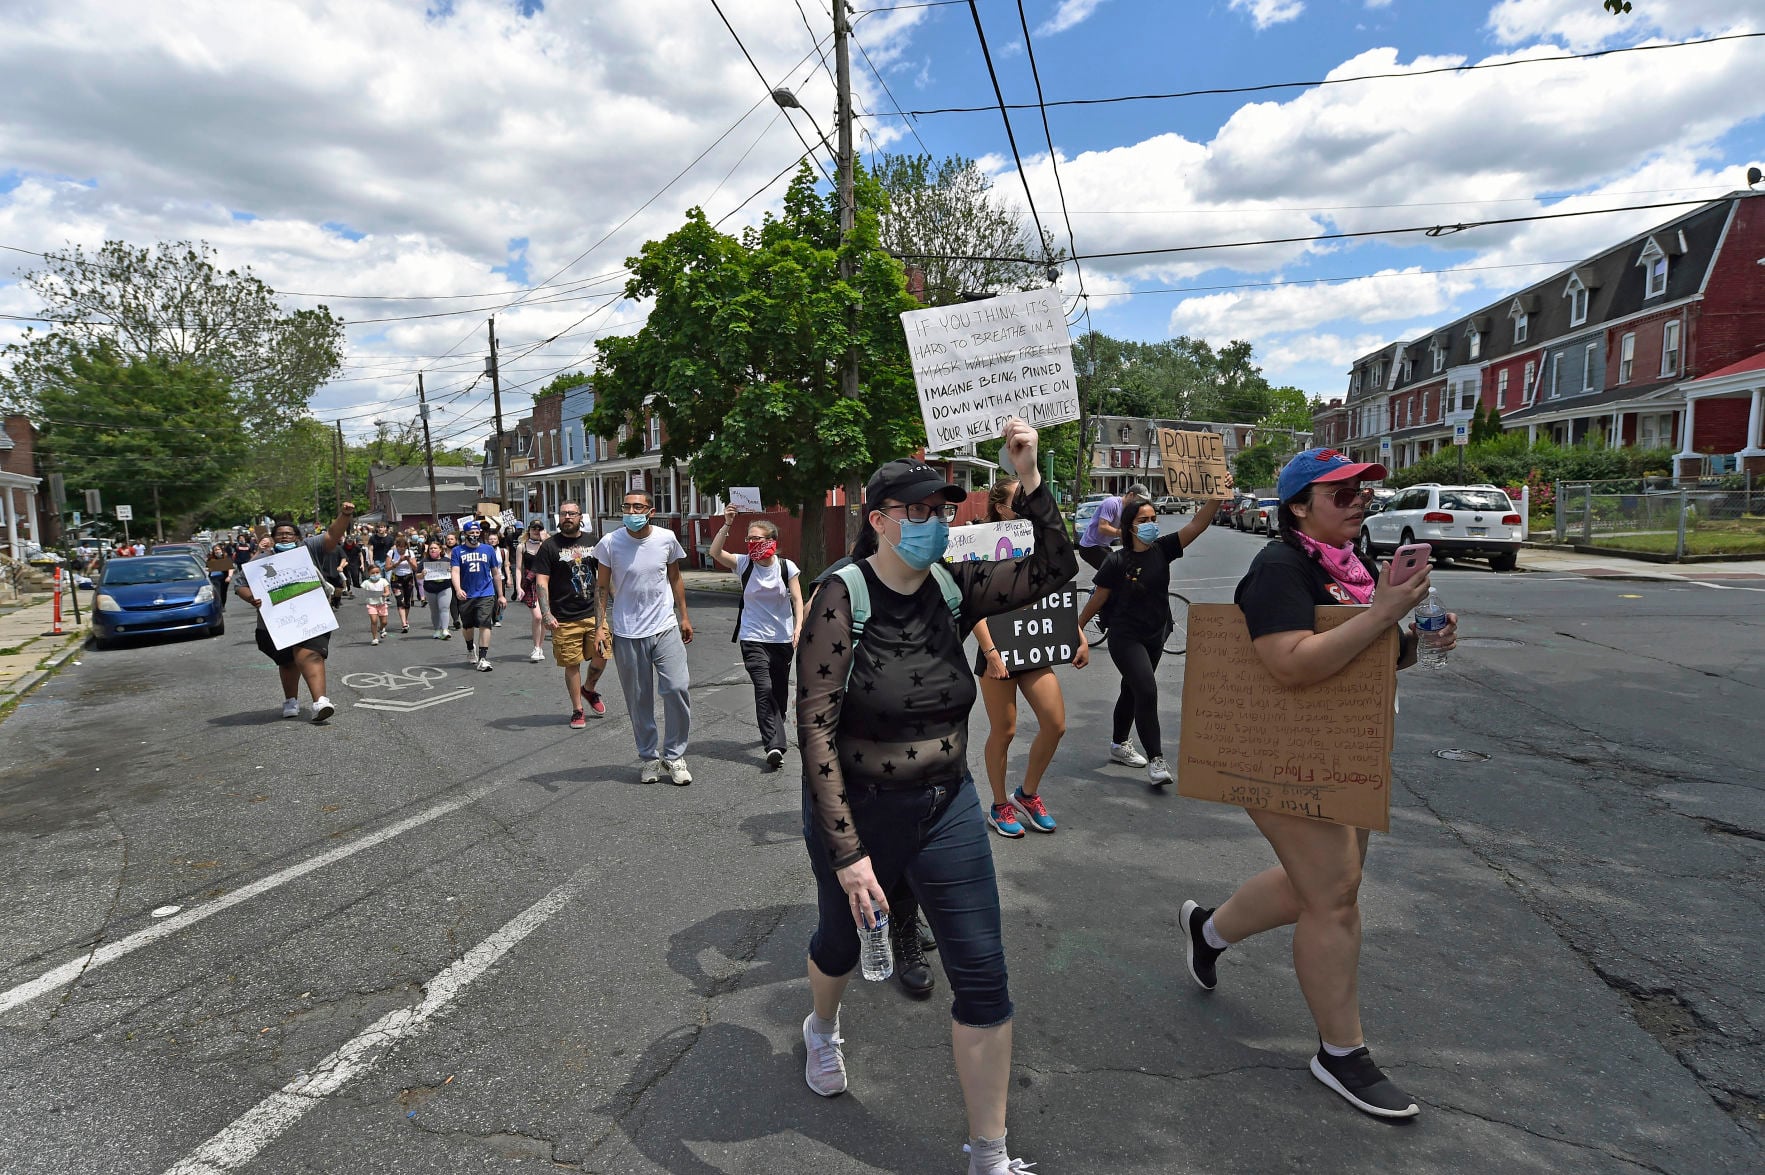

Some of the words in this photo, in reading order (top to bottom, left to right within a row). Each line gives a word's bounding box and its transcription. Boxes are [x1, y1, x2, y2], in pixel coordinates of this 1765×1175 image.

[915, 319, 932, 337] IF
[939, 312, 971, 331] YOU
[974, 305, 1019, 323] THINK
[1025, 299, 1050, 316] IT'S
[913, 343, 947, 360] HARD
[950, 339, 968, 349] TO
[971, 325, 1026, 346] BREATHE
[1031, 322, 1043, 333] IN
[1046, 320, 1054, 330] A
[920, 363, 961, 383] MASK
[964, 351, 1016, 370] WALKING
[924, 380, 974, 401] IMAGINE
[979, 371, 1017, 387] BEING
[1022, 362, 1062, 379] PINNED
[932, 401, 971, 420] DOWN
[973, 395, 1002, 411] WITH
[1014, 385, 1050, 400] KNEE
[1053, 380, 1070, 392] ON
[936, 425, 962, 443] YOUR
[967, 419, 991, 436] NECK
[1019, 406, 1030, 423] 9
[1032, 399, 1077, 421] MINUTES
[1164, 432, 1221, 461] POLICE
[1178, 459, 1207, 473] THE
[1168, 467, 1224, 495] POLICE
[460, 552, 488, 564] PHILA
[469, 562, 480, 572] 21
[1014, 618, 1053, 636] FOR
[1001, 644, 1071, 666] FLOYD
[1320, 765, 1383, 790] George
